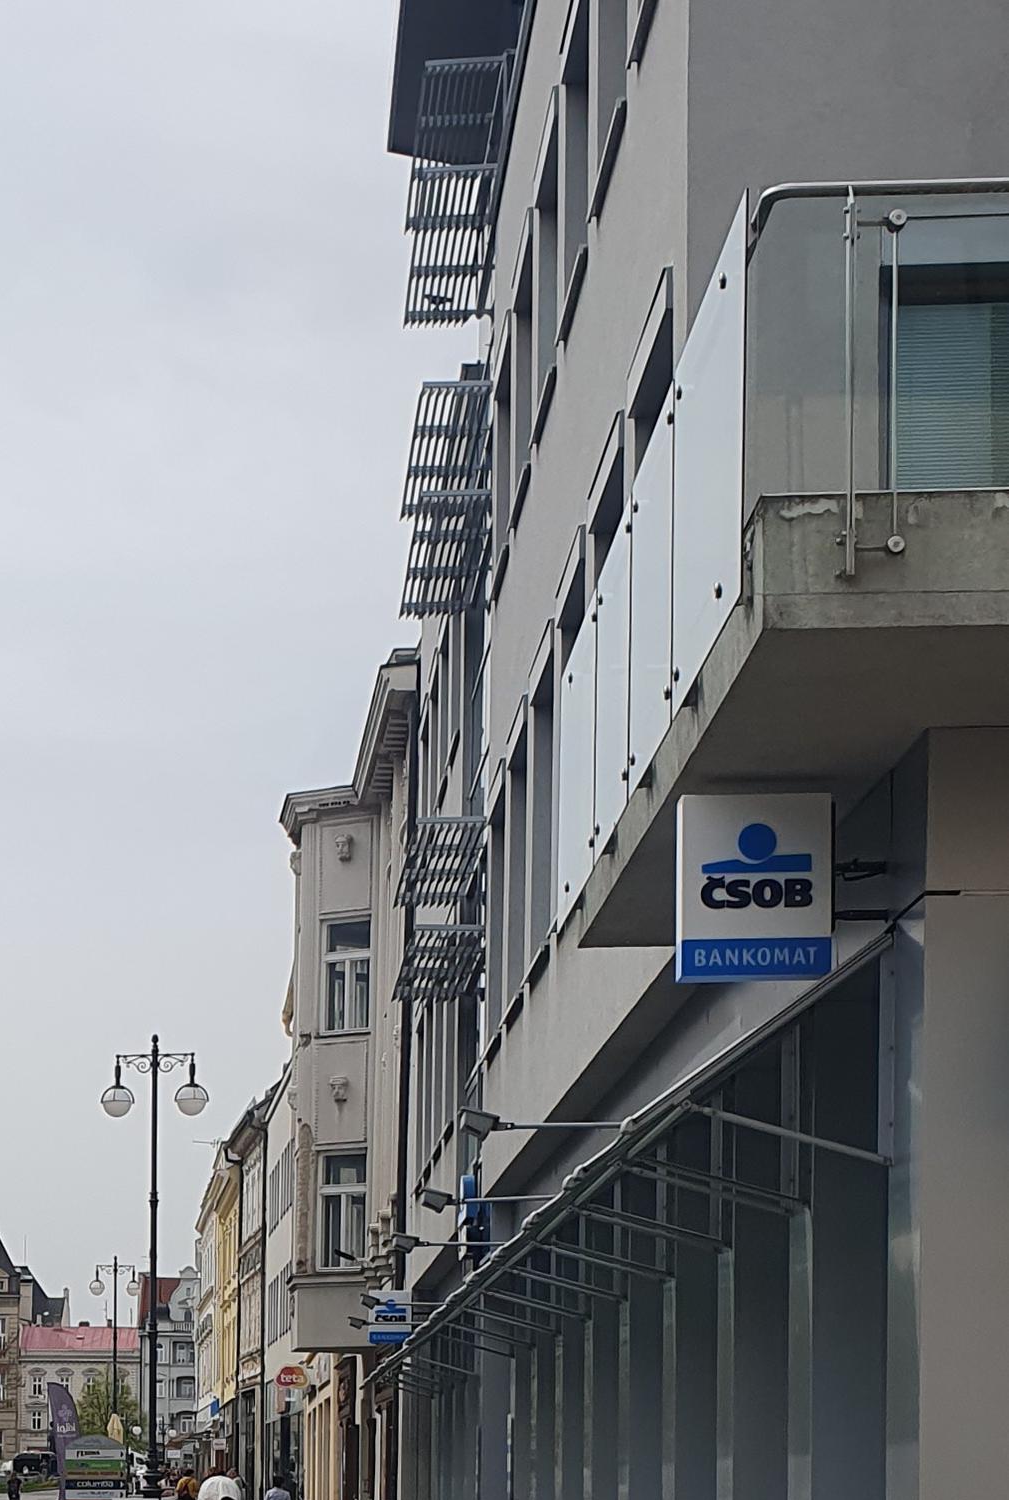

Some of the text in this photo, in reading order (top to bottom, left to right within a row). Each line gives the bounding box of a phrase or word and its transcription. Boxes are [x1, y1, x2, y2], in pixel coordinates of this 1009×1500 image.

[700, 875, 813, 909] ČSOB
[694, 947, 818, 967] BANKOMAT
[280, 1374, 304, 1383] teta
